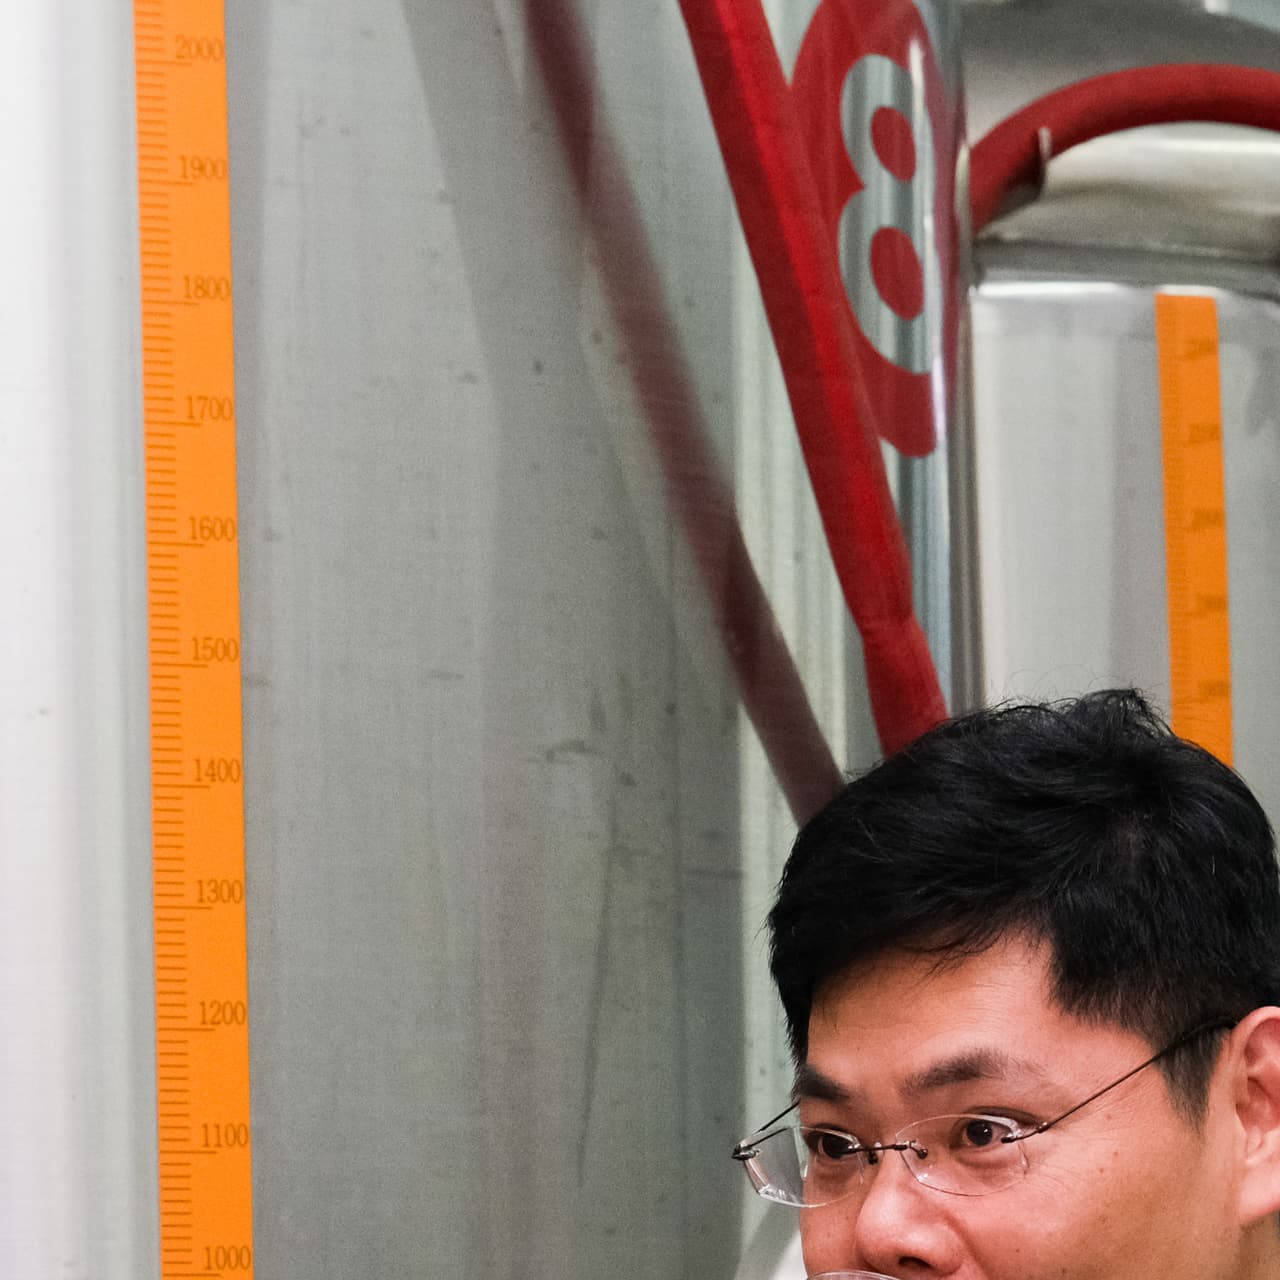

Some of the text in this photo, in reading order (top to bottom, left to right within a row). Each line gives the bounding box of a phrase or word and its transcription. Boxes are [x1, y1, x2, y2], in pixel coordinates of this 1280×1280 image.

[177, 36, 222, 61] 2000
[180, 157, 225, 181] 1900
[839, 53, 943, 374] 8
[183, 277, 230, 301] 1800
[186, 398, 233, 421] 1700
[189, 518, 235, 542] 1600
[192, 638, 238, 662] 1500
[194, 759, 241, 783] 1400
[197, 880, 243, 904] 1300
[199, 1001, 246, 1026] 1200
[202, 1123, 248, 1148] 1100
[204, 1246, 251, 1271] 1000
